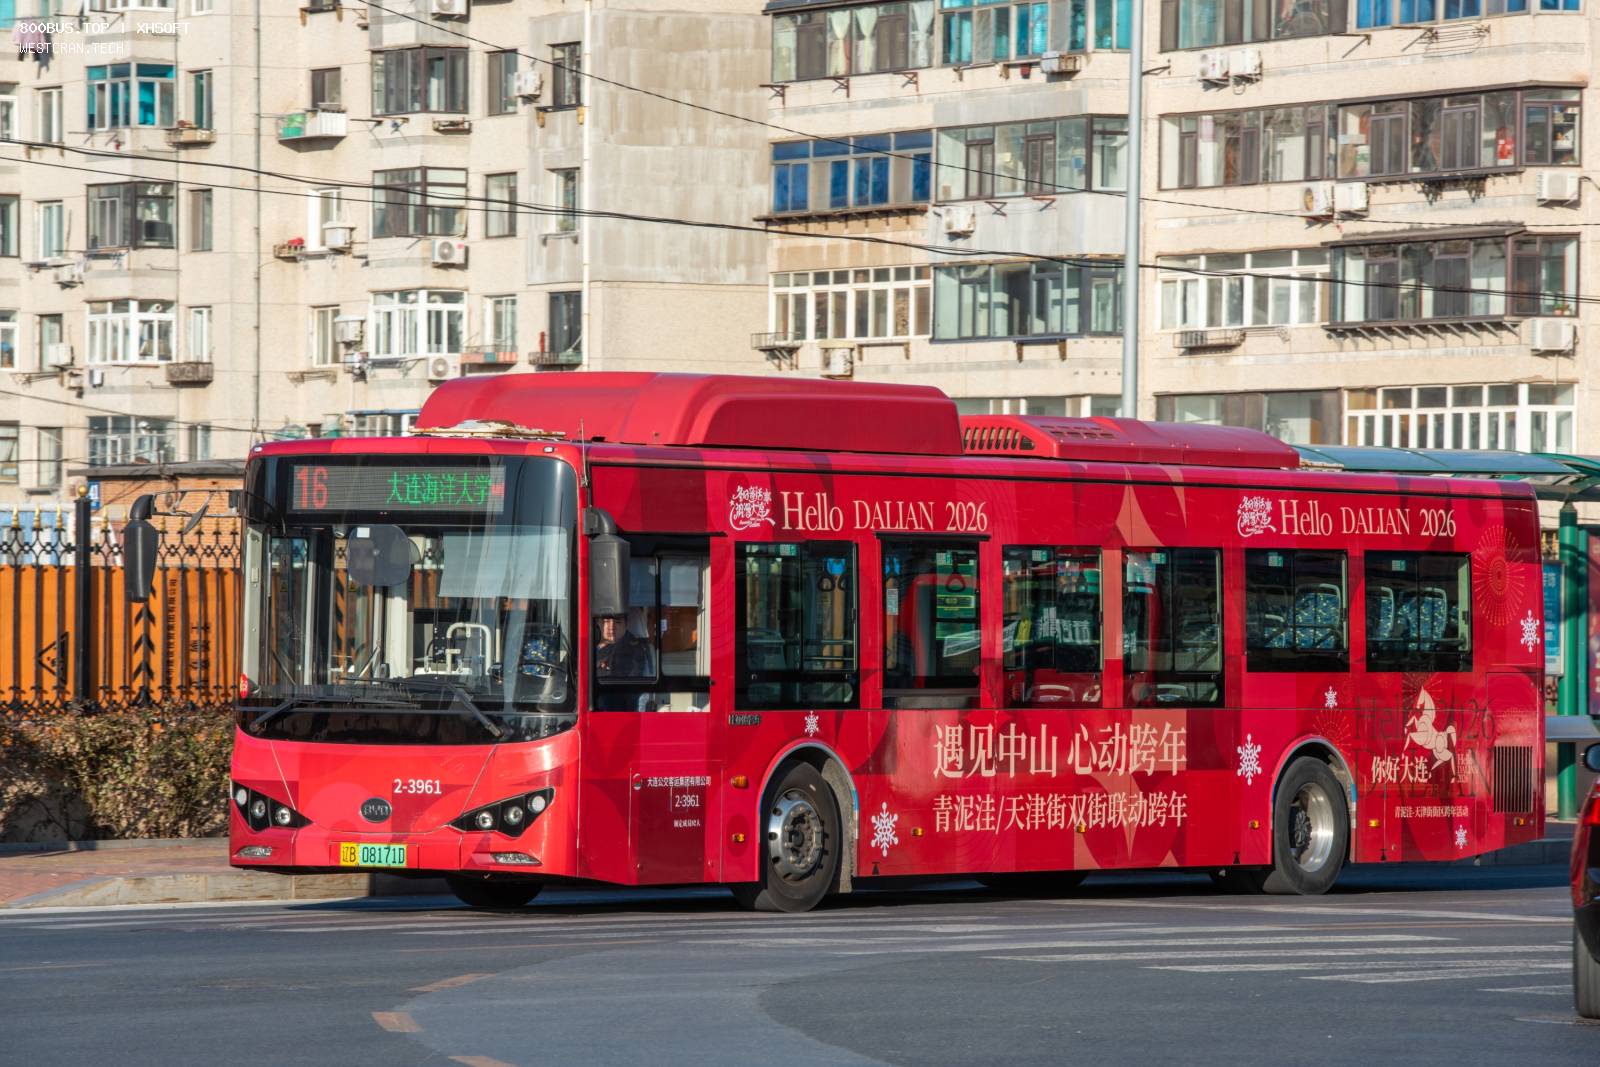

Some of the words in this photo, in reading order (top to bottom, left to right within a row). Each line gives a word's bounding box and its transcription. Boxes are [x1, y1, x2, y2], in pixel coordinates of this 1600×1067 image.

[295, 466, 329, 509] 16
[386, 472, 492, 505] 大连海洋大学
[780, 491, 844, 532] Hello
[853, 500, 935, 531] DALIAN
[945, 501, 988, 532] 2026
[1278, 499, 1333, 537] Hello
[1341, 507, 1411, 536] DALIAN
[1420, 508, 1457, 537] 2026
[933, 722, 1058, 779] 遇见中山
[1067, 721, 1188, 778] 心动跨年
[1371, 753, 1429, 784] 你好大连
[393, 778, 442, 795] 2-3961
[675, 794, 700, 808] 2-3961
[933, 790, 1188, 835] 青泥洼/天津街双街联动跨年
[362, 846, 406, 864] 08171D
